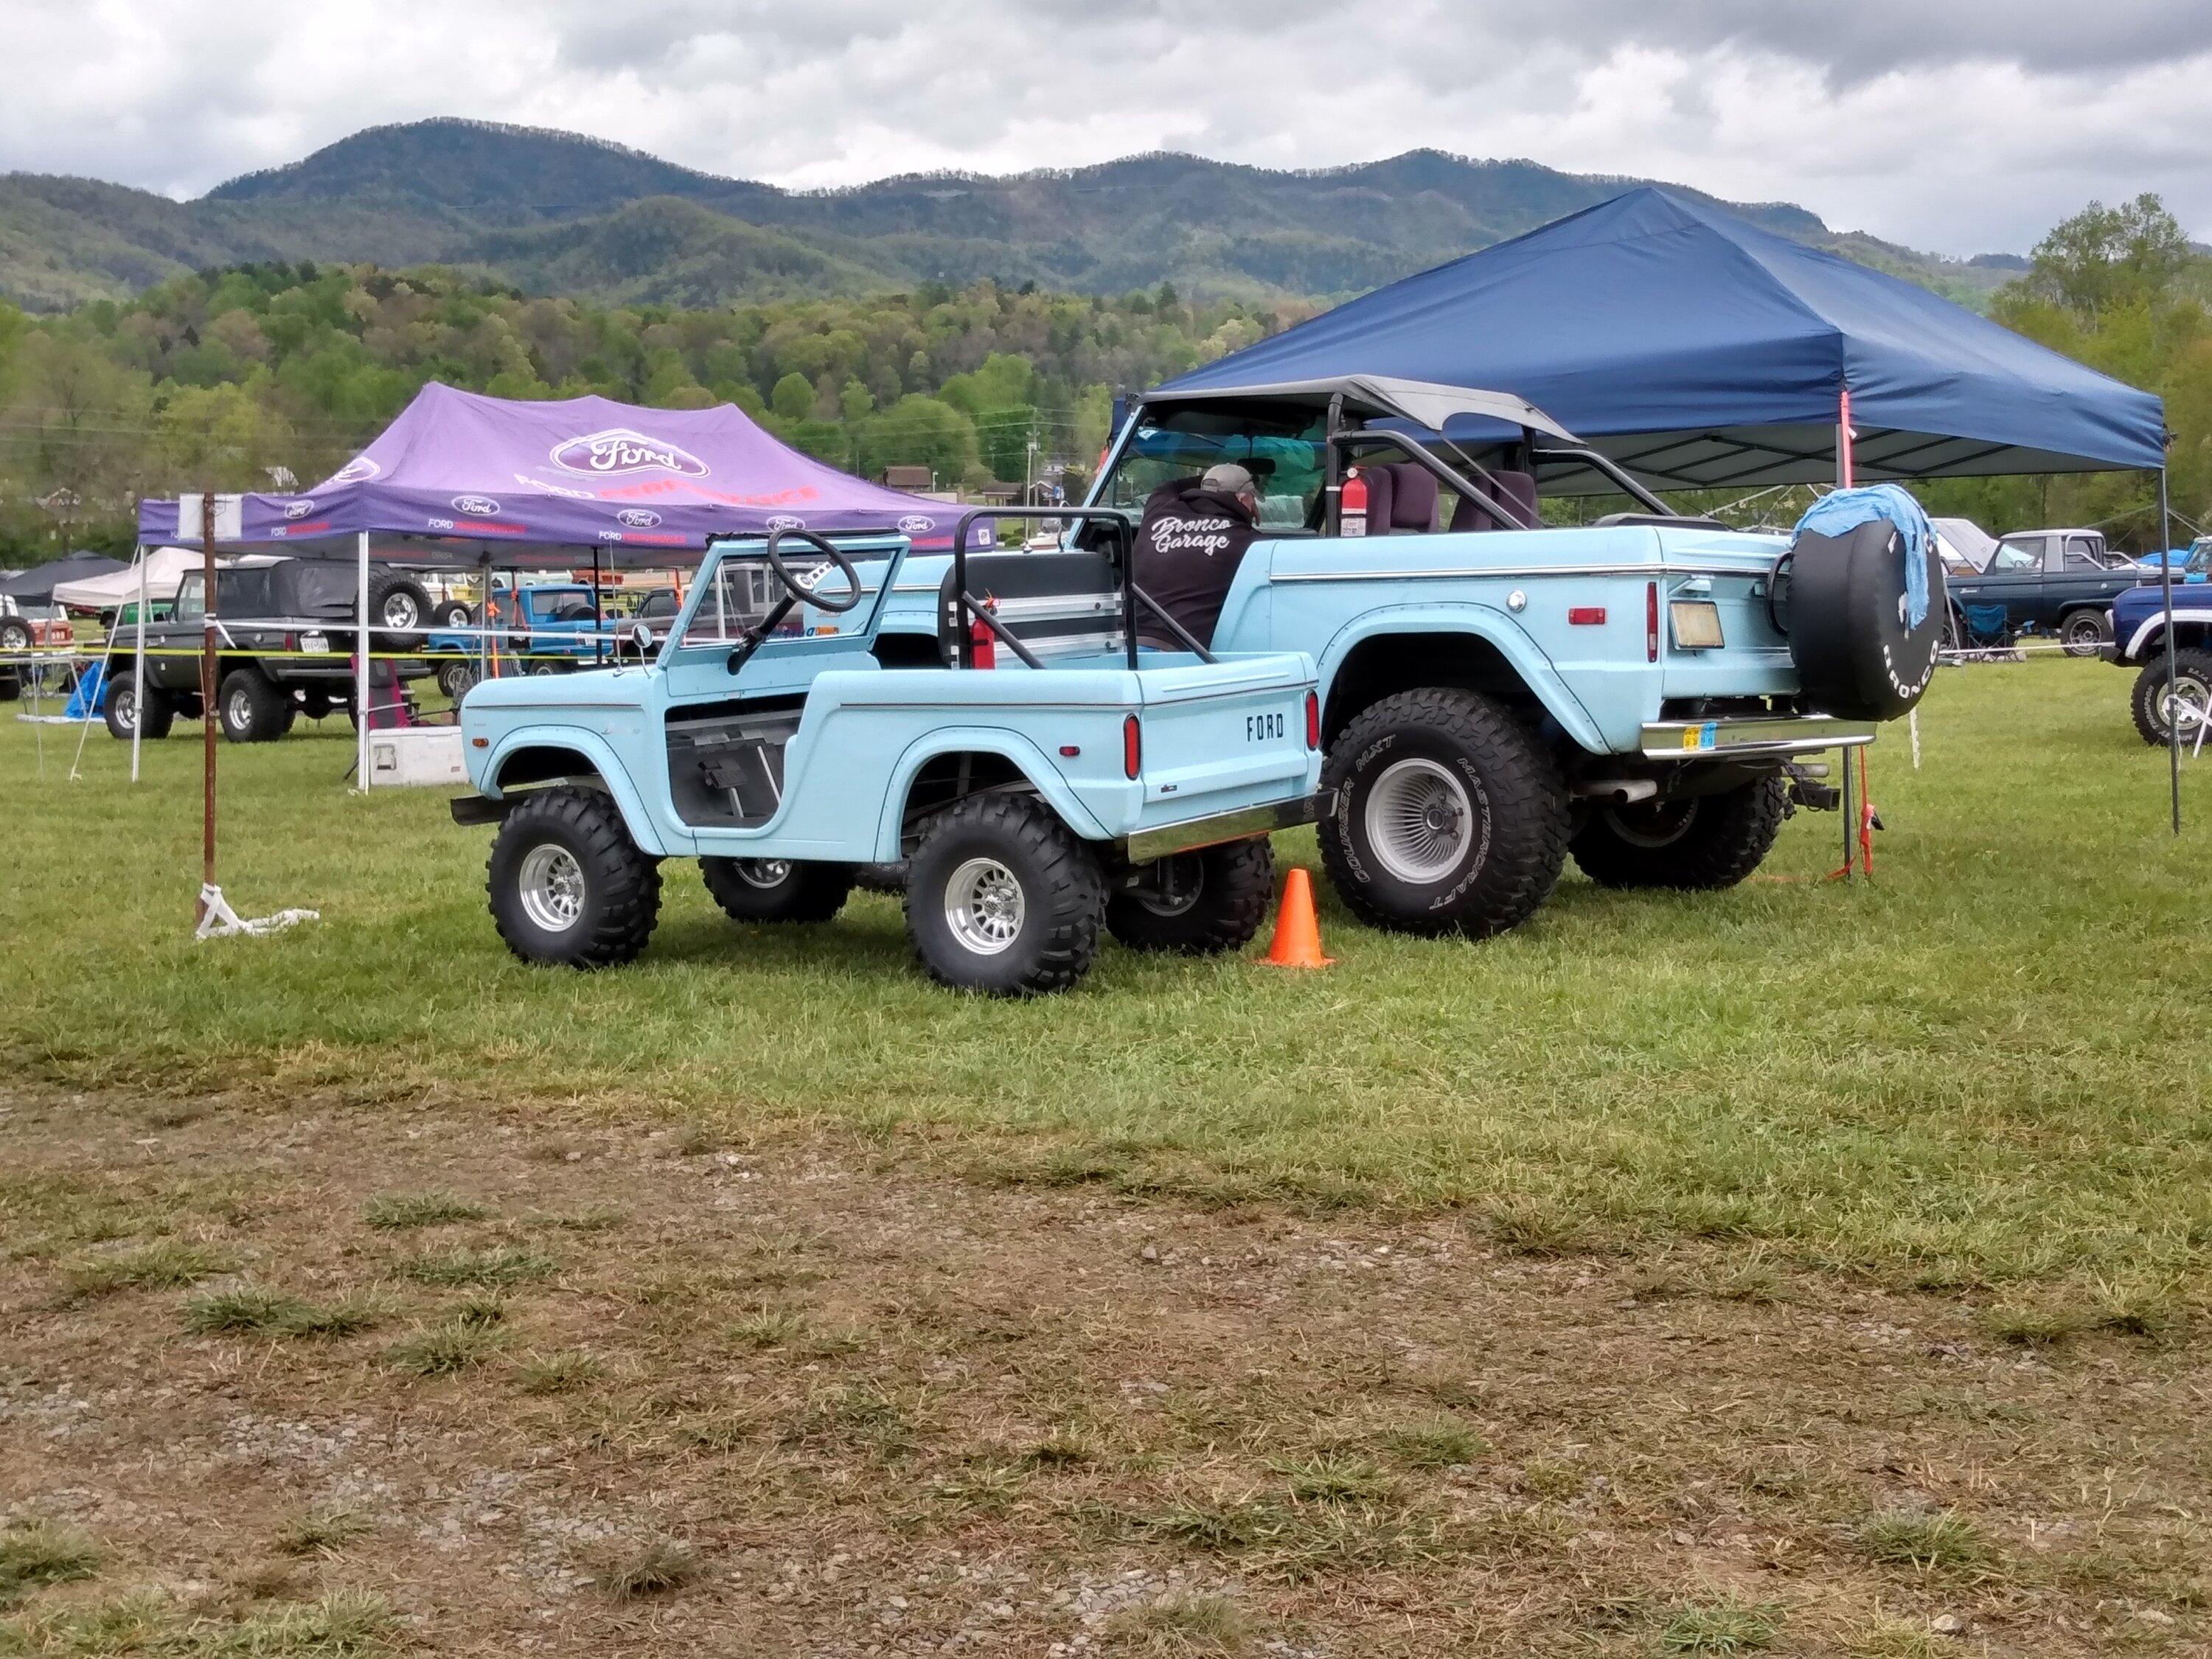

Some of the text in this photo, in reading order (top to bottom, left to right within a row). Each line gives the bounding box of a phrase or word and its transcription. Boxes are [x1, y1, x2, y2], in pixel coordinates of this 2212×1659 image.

[590, 438, 682, 470] Ford
[462, 499, 492, 513] Ford
[428, 518, 454, 529] FORD
[626, 511, 654, 526] Ford
[905, 518, 928, 529] Ford
[1150, 517, 1234, 540] Bronco
[599, 531, 622, 540] FORD
[1155, 534, 1230, 556] Garage
[1883, 639, 1939, 699] BRONCO
[1247, 713, 1284, 742] FORD
[1355, 734, 1397, 772] MXT
[1338, 776, 1371, 883] COURSER
[1428, 757, 1492, 911] MASTERCRAFT
